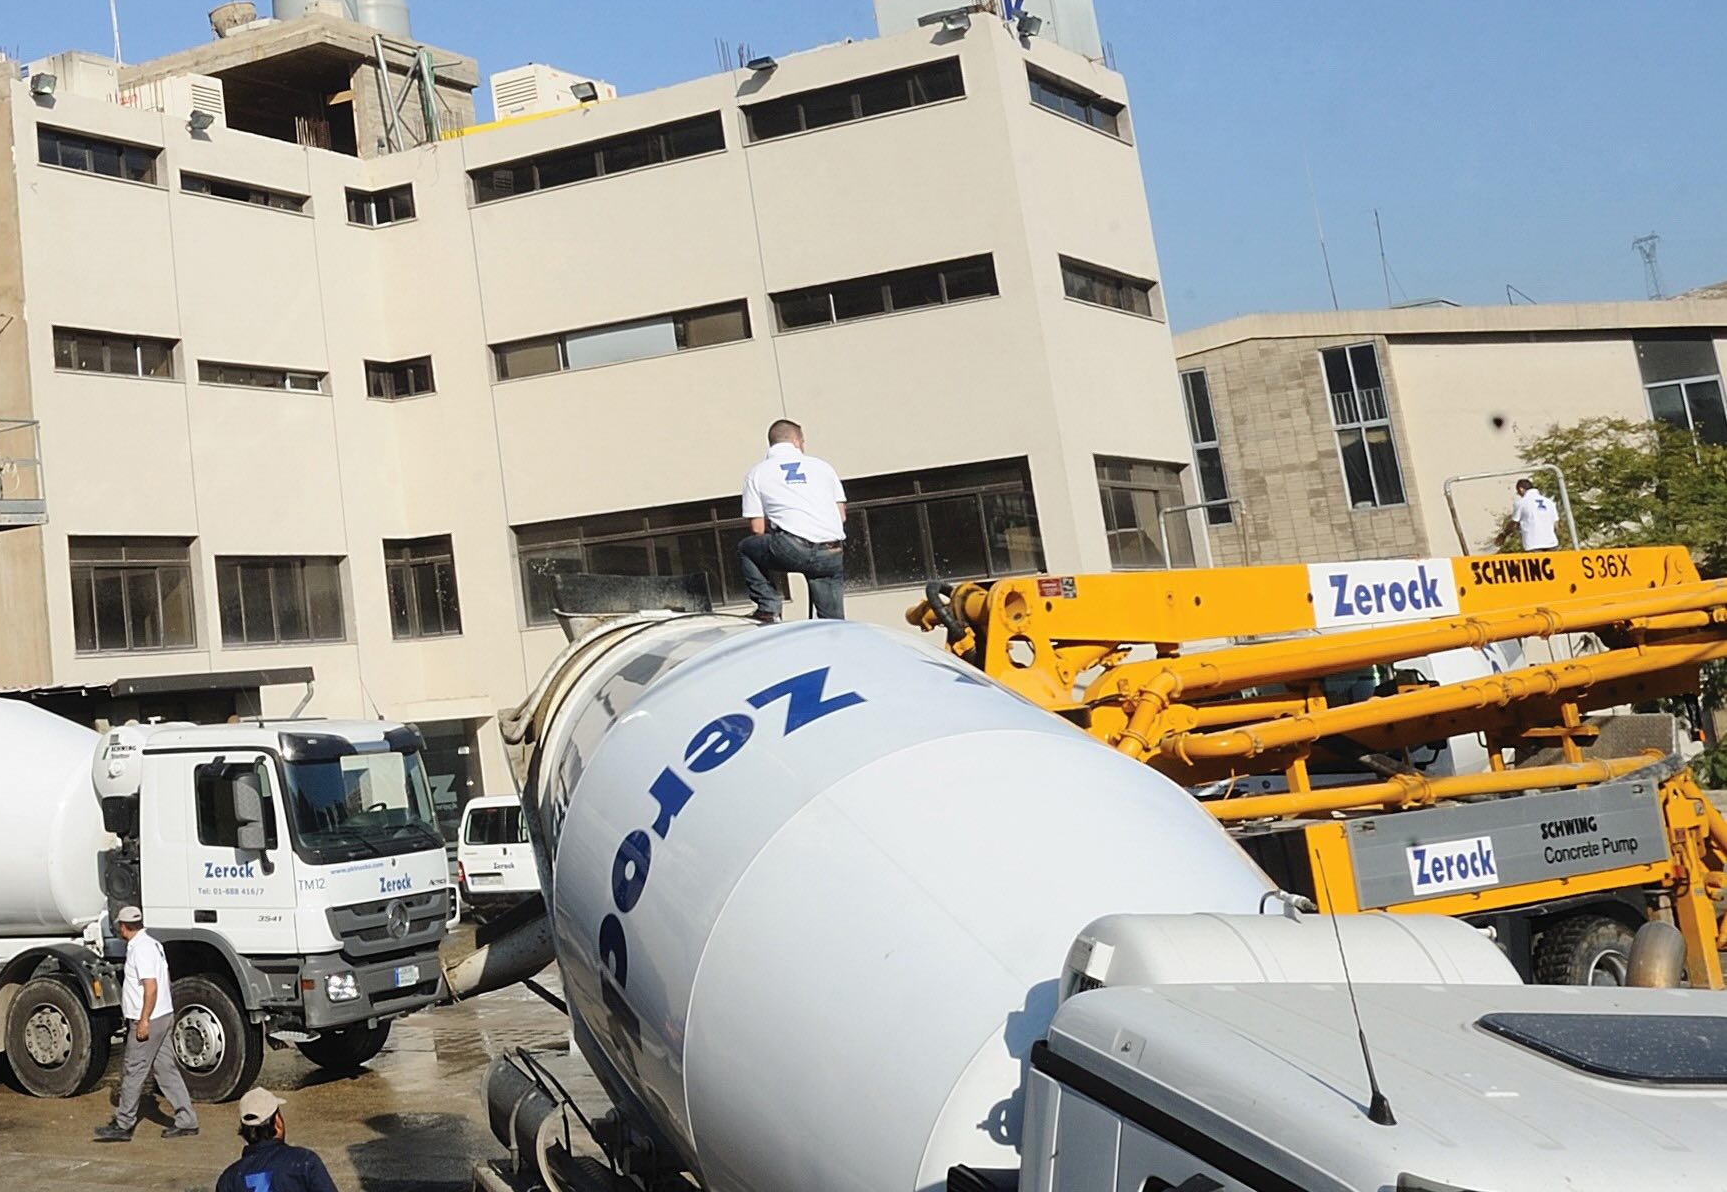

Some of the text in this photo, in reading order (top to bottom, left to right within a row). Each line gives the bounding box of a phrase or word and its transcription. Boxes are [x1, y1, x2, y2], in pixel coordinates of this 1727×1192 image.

[780, 462, 806, 480] Z
[1471, 558, 1555, 585] SCHWING
[1329, 565, 1442, 617] Zerock
[429, 774, 457, 803] Z
[1540, 816, 1598, 839] SCHWING
[1413, 840, 1495, 885] Zerock
[1544, 837, 1638, 864] Concrete Pump
[204, 861, 254, 878] Zerock
[298, 878, 325, 890] TM12
[379, 872, 412, 893] Zerock
